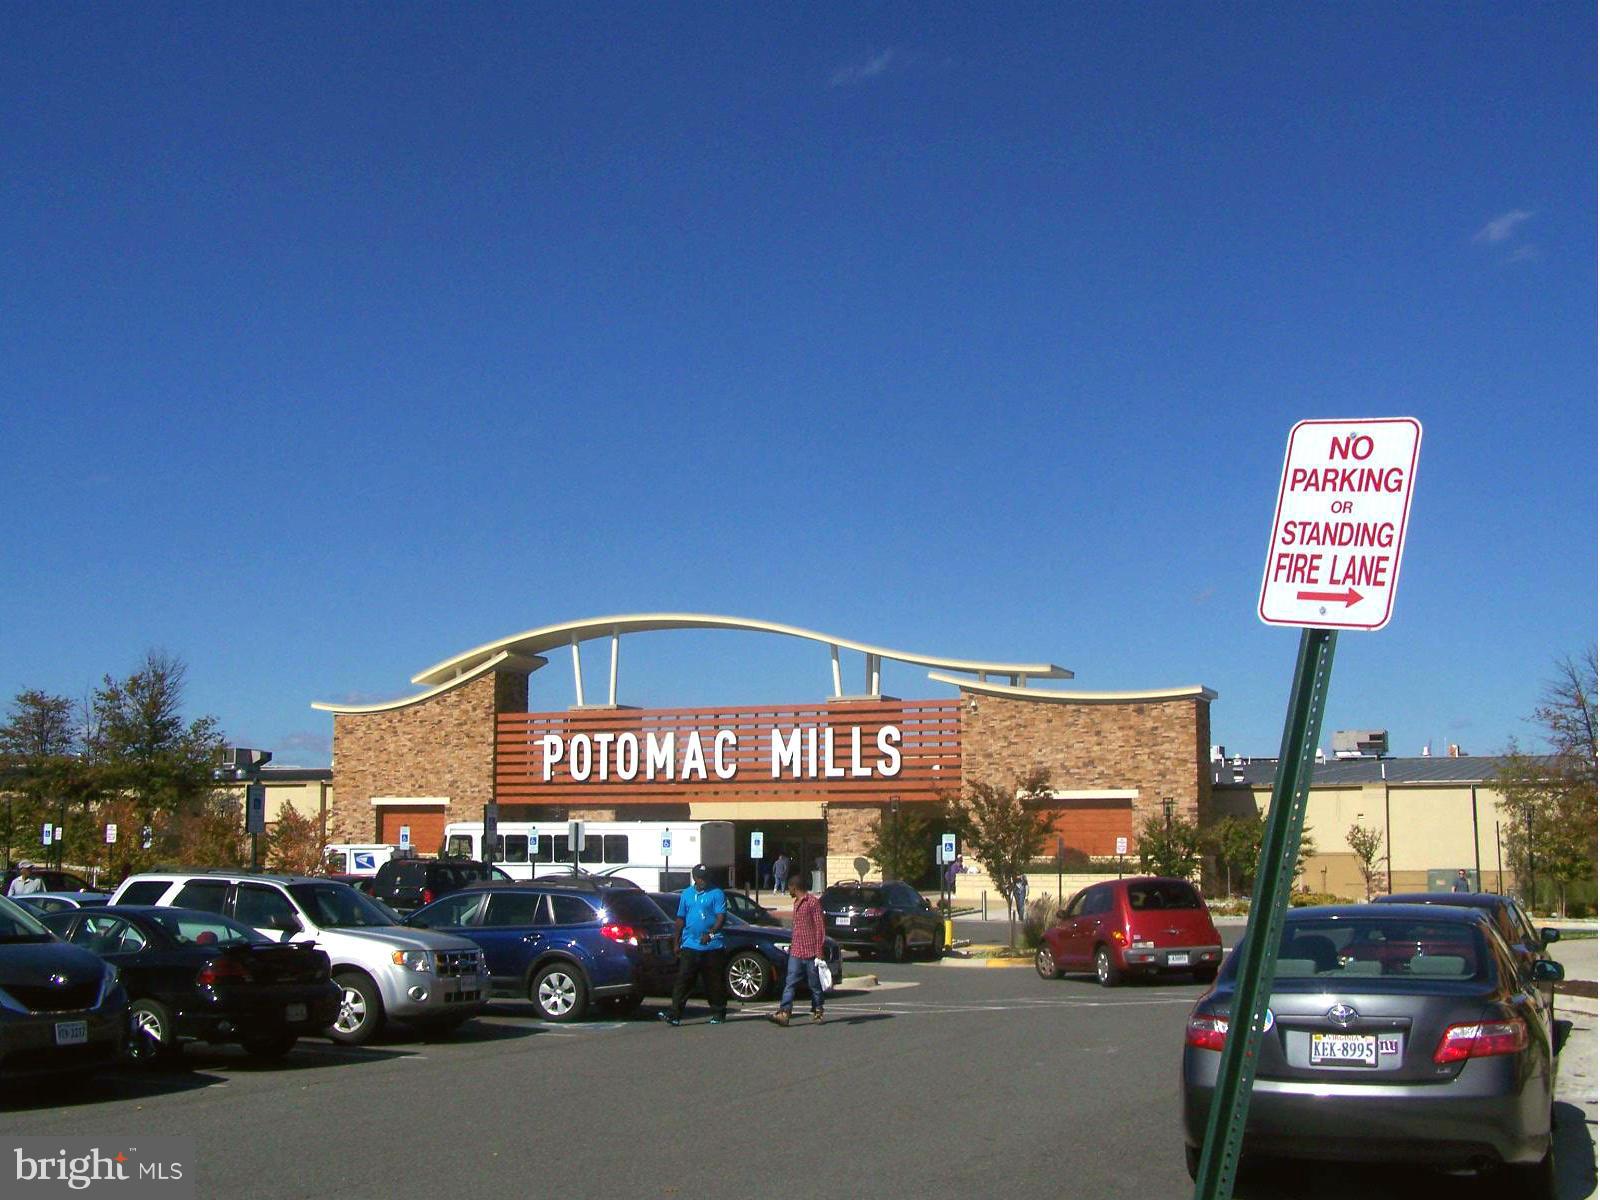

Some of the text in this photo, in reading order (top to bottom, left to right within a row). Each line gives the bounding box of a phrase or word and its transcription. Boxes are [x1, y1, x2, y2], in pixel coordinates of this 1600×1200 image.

[1329, 435, 1374, 461] NO
[1290, 467, 1404, 493] PARKING
[1330, 500, 1354, 514] OR
[1281, 520, 1395, 548] STANDING
[1274, 552, 1390, 587] FIRE LANE
[542, 725, 902, 782] POTOMAC MILLS
[1313, 1041, 1374, 1057] KEK-8995
